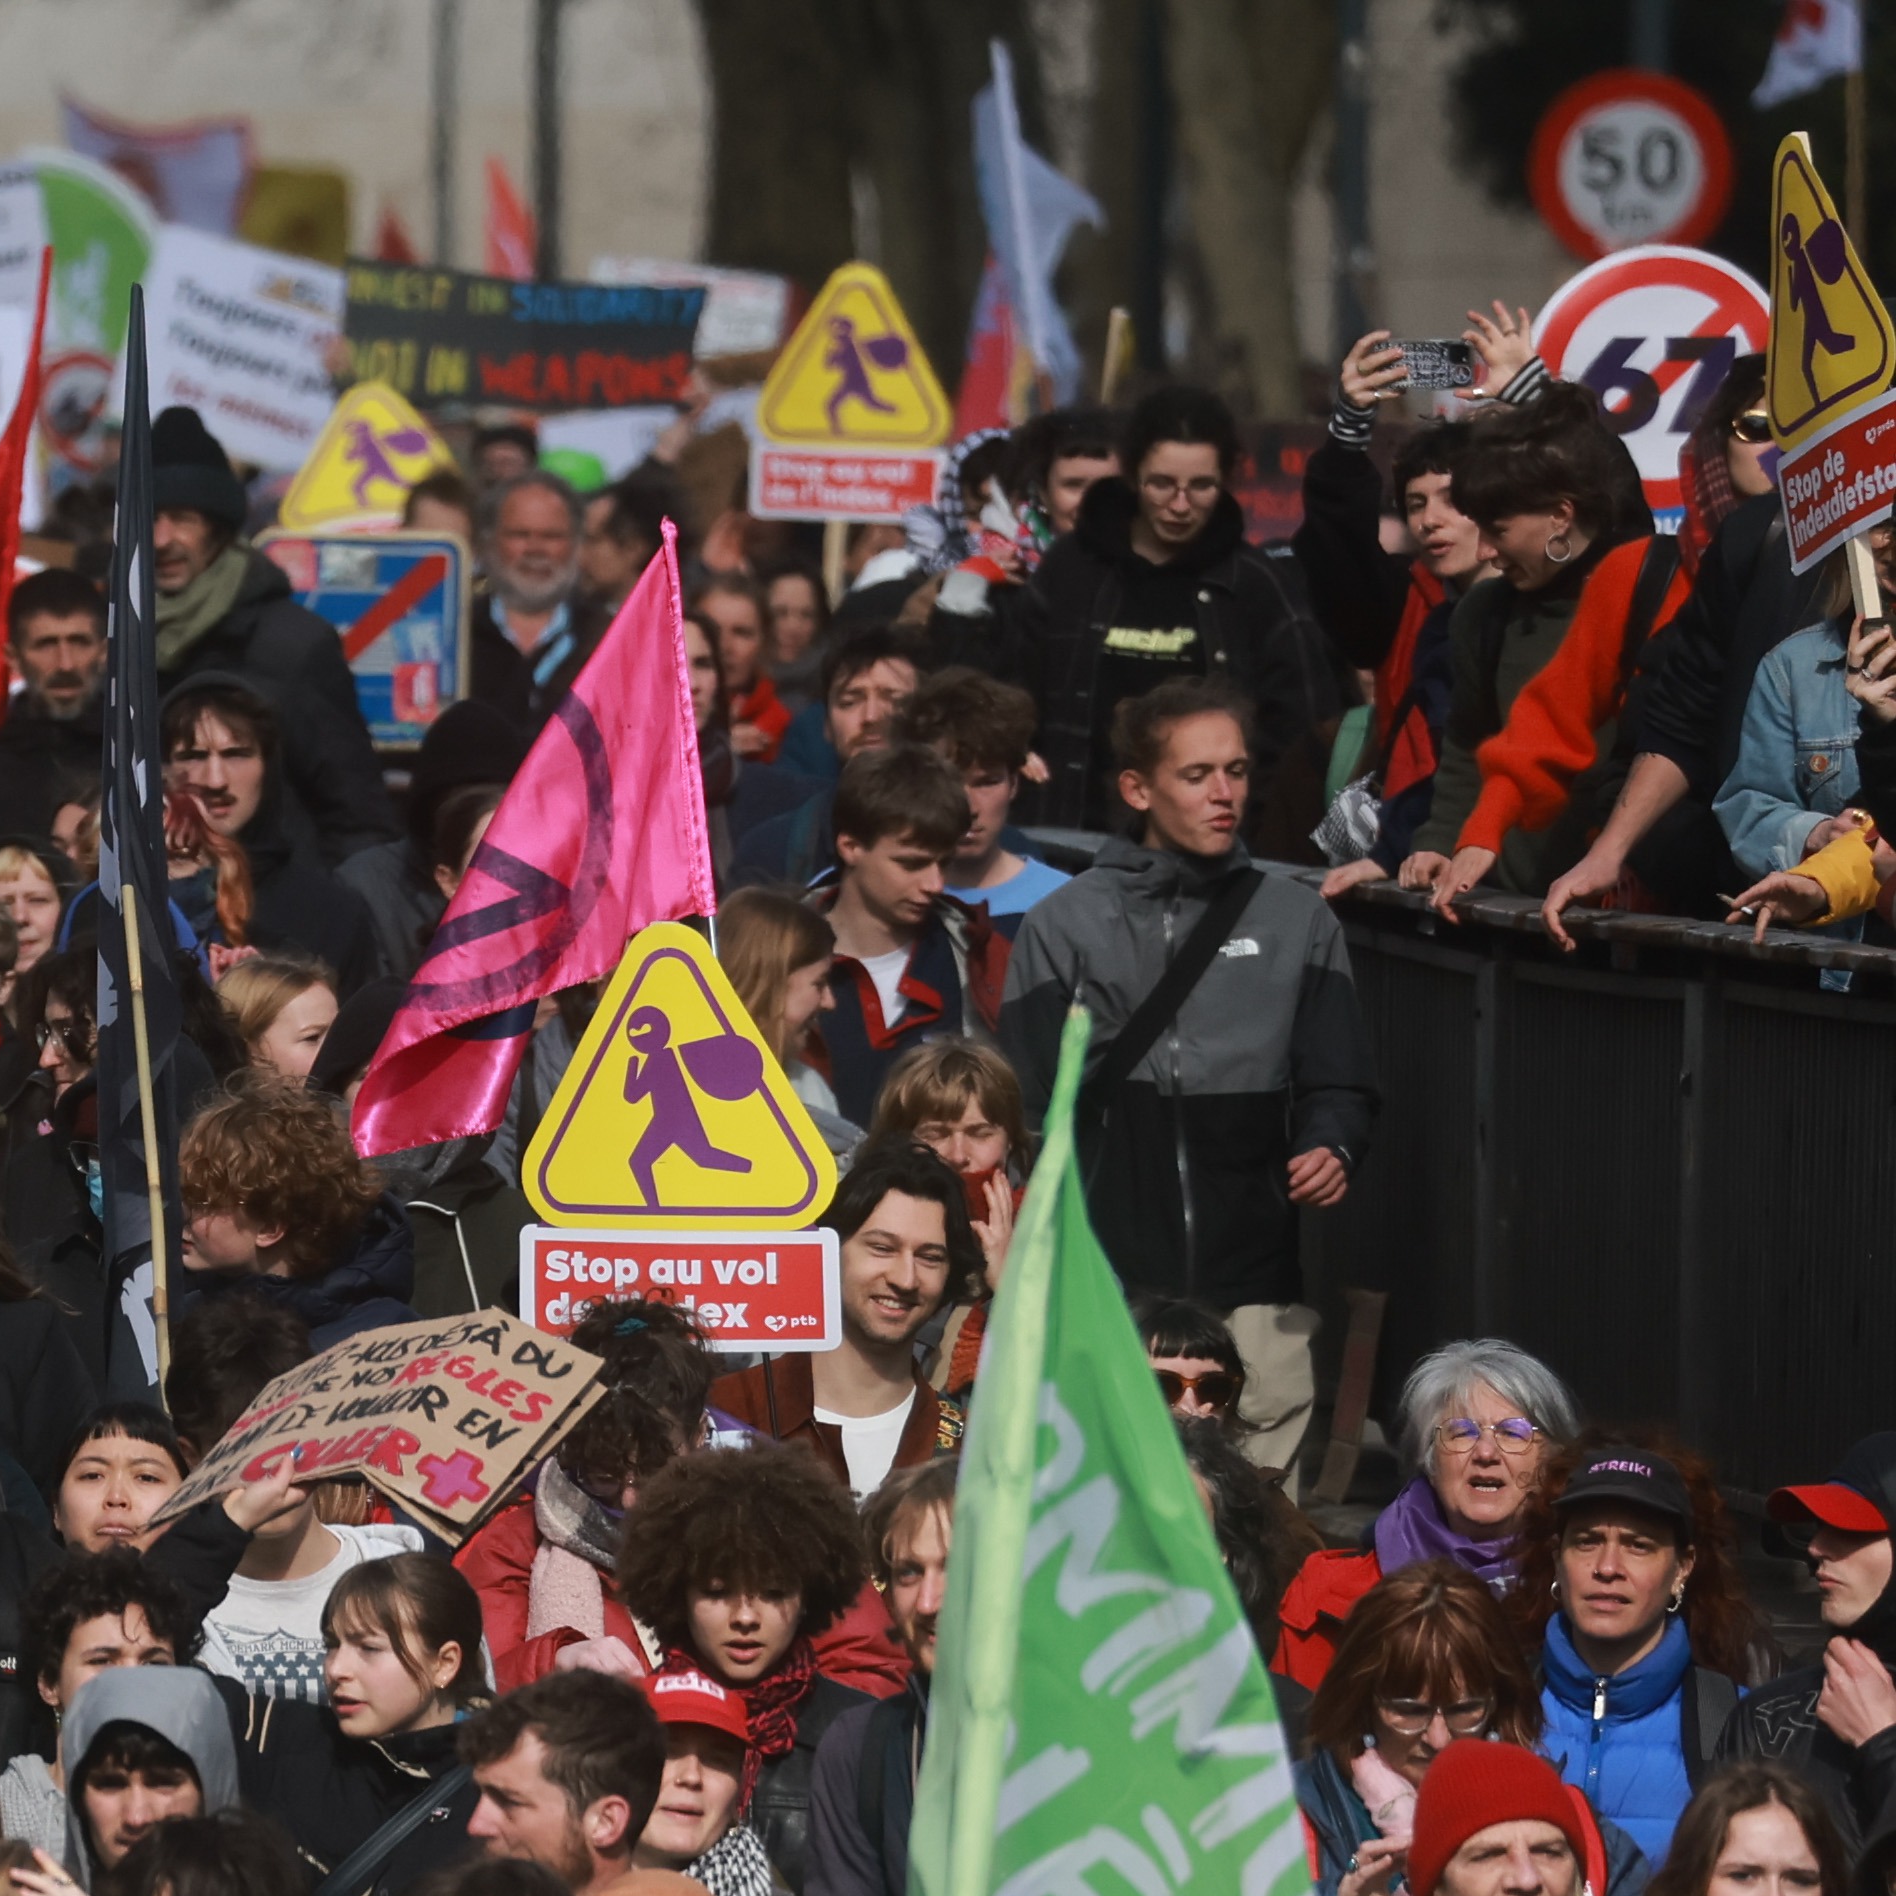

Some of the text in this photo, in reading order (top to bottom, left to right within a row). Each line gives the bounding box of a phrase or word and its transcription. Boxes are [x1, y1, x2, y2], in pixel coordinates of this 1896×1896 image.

[1581, 124, 1682, 193] 50
[1577, 335, 1736, 435] 67
[1786, 448, 1845, 509] Stop de
[544, 1249, 778, 1291] Stop au vol
[790, 1314, 818, 1329] ptb
[511, 1339, 575, 1379] DU
[453, 1407, 524, 1450] EN
